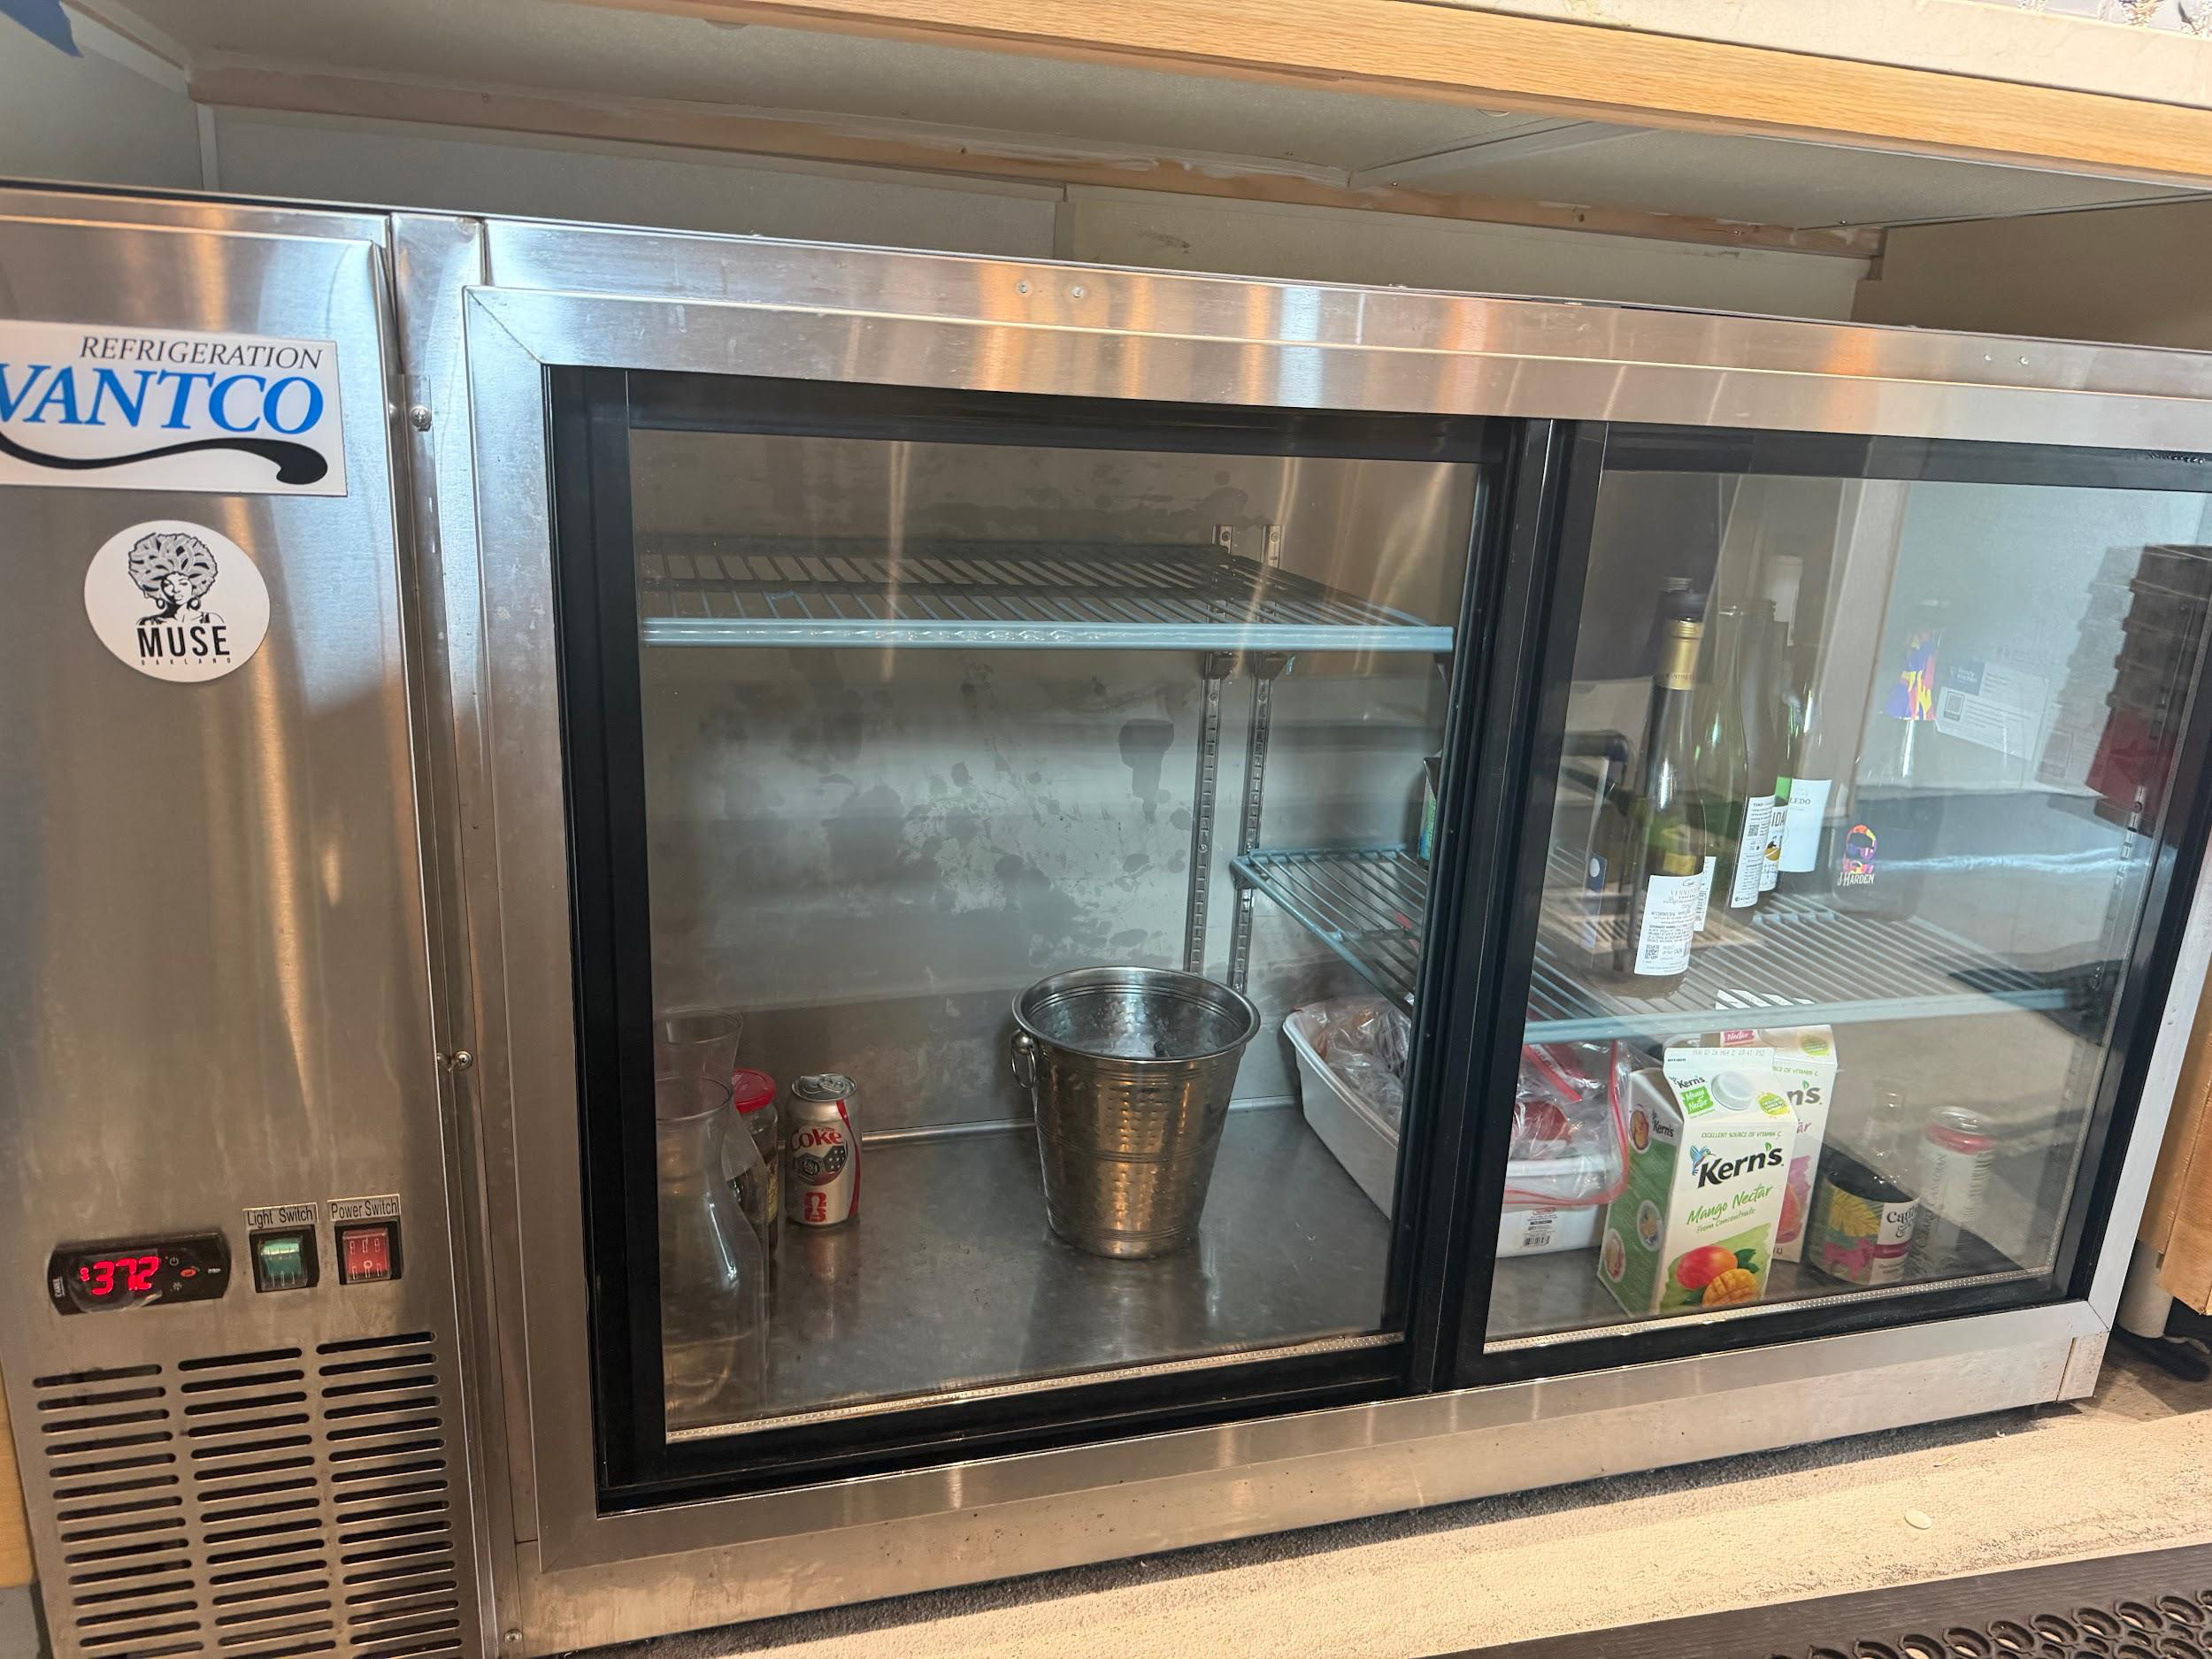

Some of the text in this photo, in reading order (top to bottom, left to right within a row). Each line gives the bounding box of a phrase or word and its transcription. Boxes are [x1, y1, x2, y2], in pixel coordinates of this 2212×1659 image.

[81, 336, 323, 370] REFRIGERATION
[137, 626, 230, 657] MUSE
[141, 657, 231, 666] OAKLAND
[1677, 1075, 1706, 1088] Kern's
[1653, 1119, 1675, 1138] Kern's
[1697, 1142, 1784, 1189] Kern's
[331, 1198, 398, 1220] Power Switch
[1686, 1184, 1773, 1225] Mango Nectar
[247, 1206, 313, 1229] Light Switch
[1696, 1207, 1756, 1233] From Concentrate
